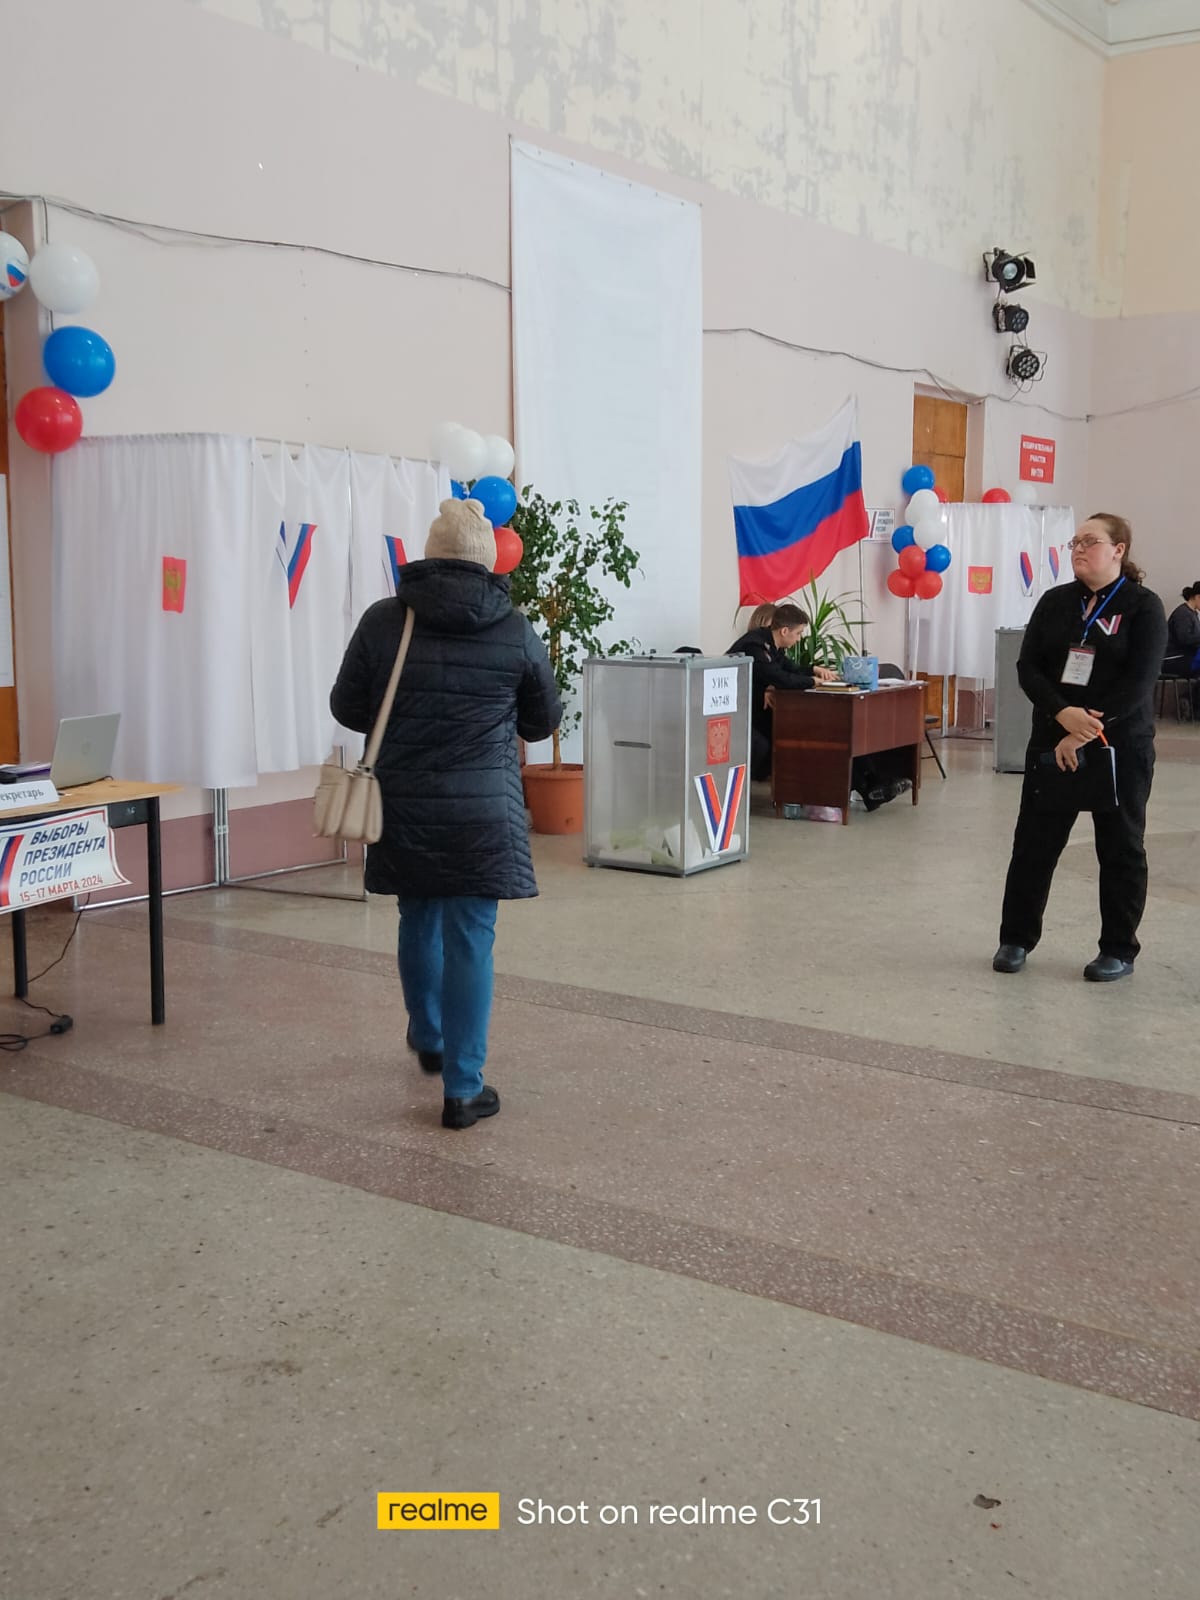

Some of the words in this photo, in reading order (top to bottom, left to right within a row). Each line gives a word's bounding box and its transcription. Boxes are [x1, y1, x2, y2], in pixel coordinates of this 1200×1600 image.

[712, 677, 729, 688] УИК
[711, 695, 730, 707] №748
[0, 789, 44, 802] екретарь
[30, 821, 89, 845] ВЫБОРЫ
[23, 836, 106, 866] ПРЕЗИДЕНТА
[19, 862, 72, 887] РОССИИ
[47, 879, 79, 896] МАРТА
[82, 874, 103, 888] 2024
